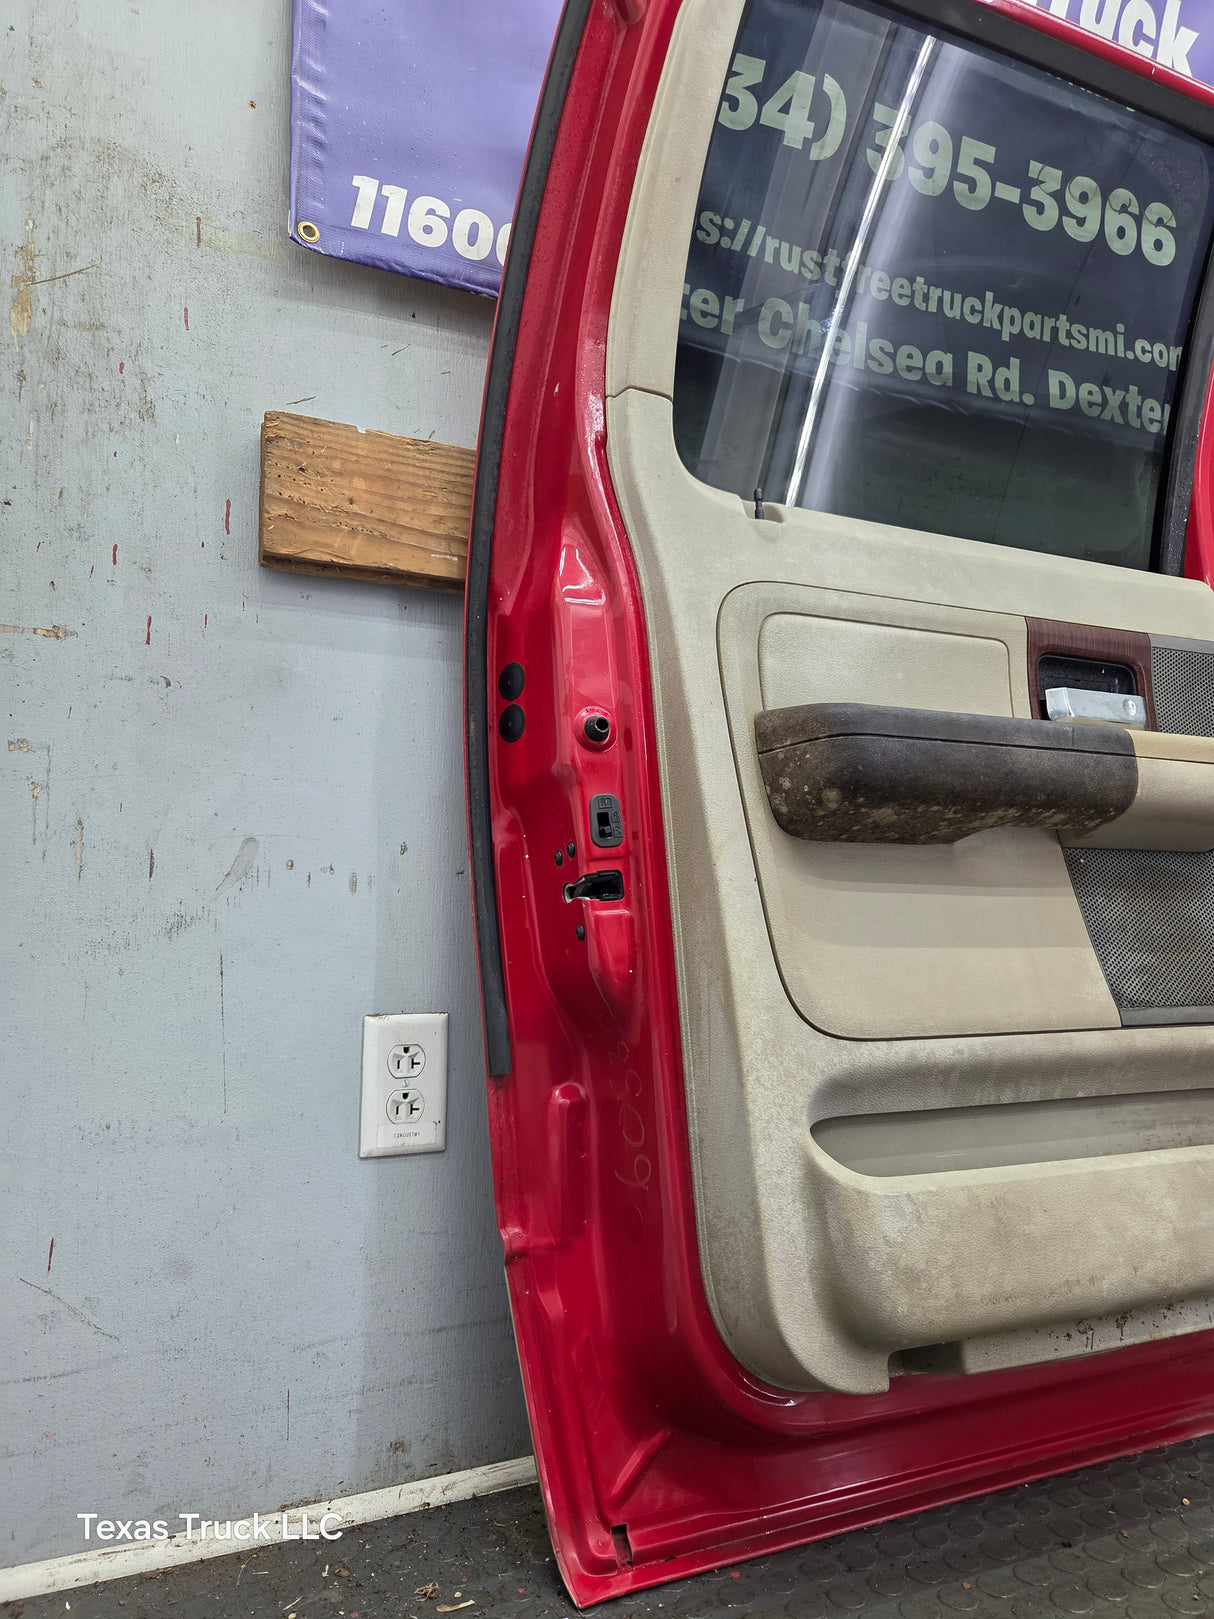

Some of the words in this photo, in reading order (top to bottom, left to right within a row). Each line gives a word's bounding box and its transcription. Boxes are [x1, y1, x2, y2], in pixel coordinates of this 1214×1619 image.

[719, 52, 847, 161] 34)
[866, 102, 1177, 267] 395-3966
[758, 297, 953, 385] Chelsea
[966, 351, 1035, 405] Rd.
